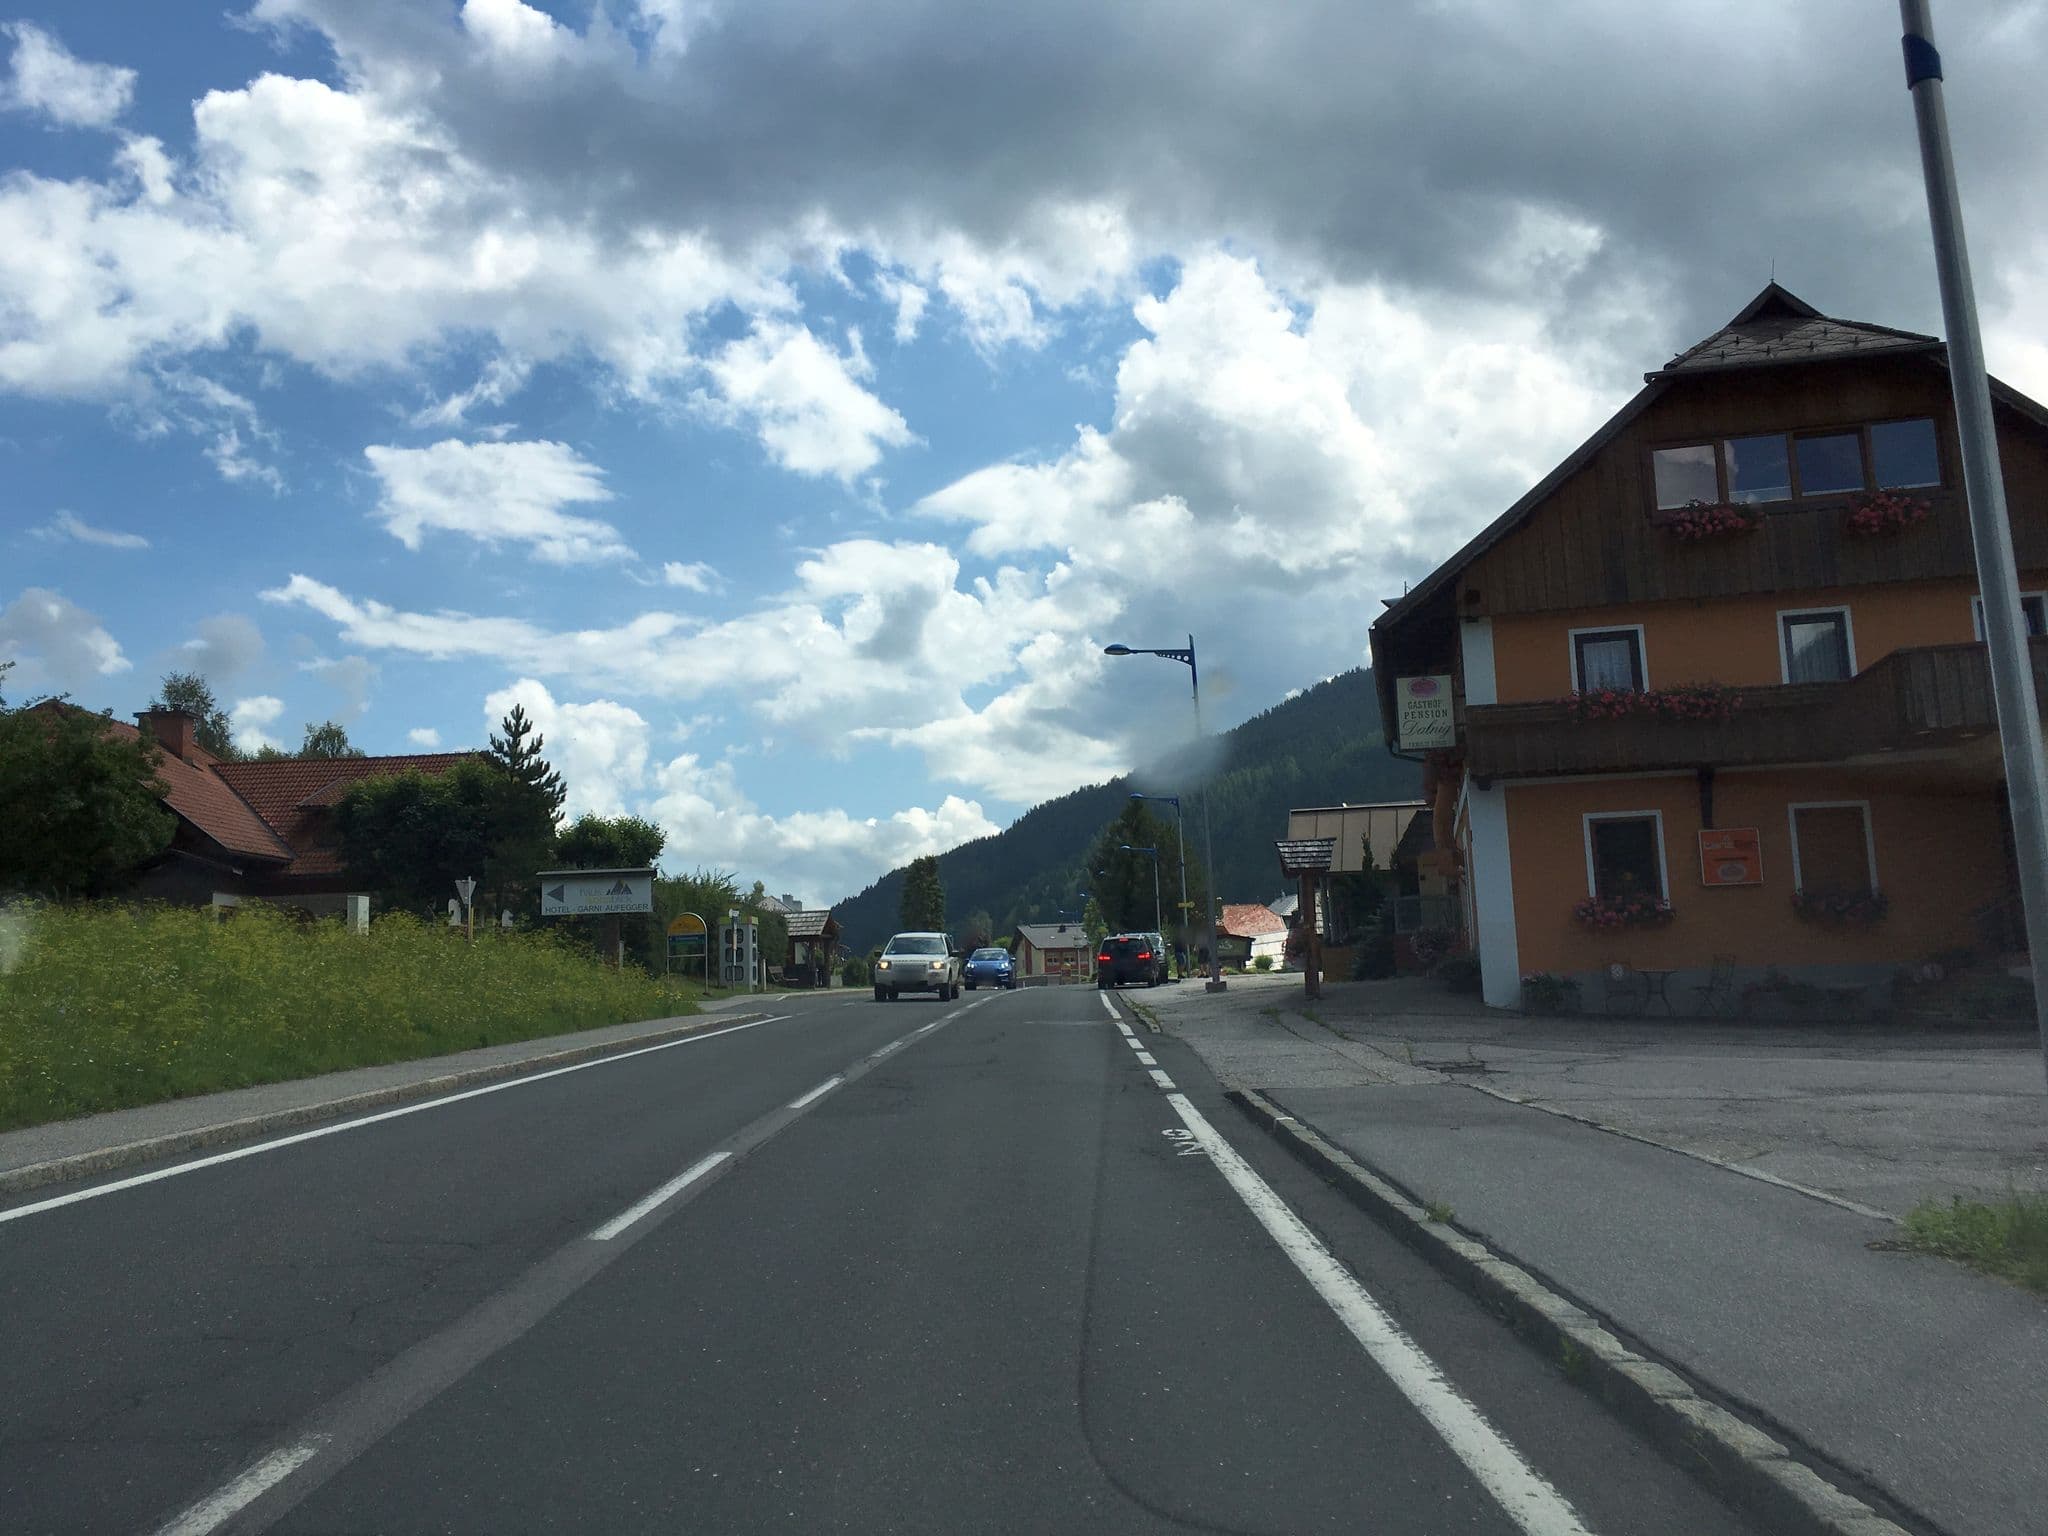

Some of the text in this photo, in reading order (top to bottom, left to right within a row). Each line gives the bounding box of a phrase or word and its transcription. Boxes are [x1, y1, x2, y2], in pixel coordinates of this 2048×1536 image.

[1407, 699, 1441, 710] GASTHOF
[1404, 709, 1448, 720] PENSION
[545, 906, 571, 914] HOTEL
[577, 904, 602, 913] GARNI
[605, 903, 650, 912] AUFEGGER
